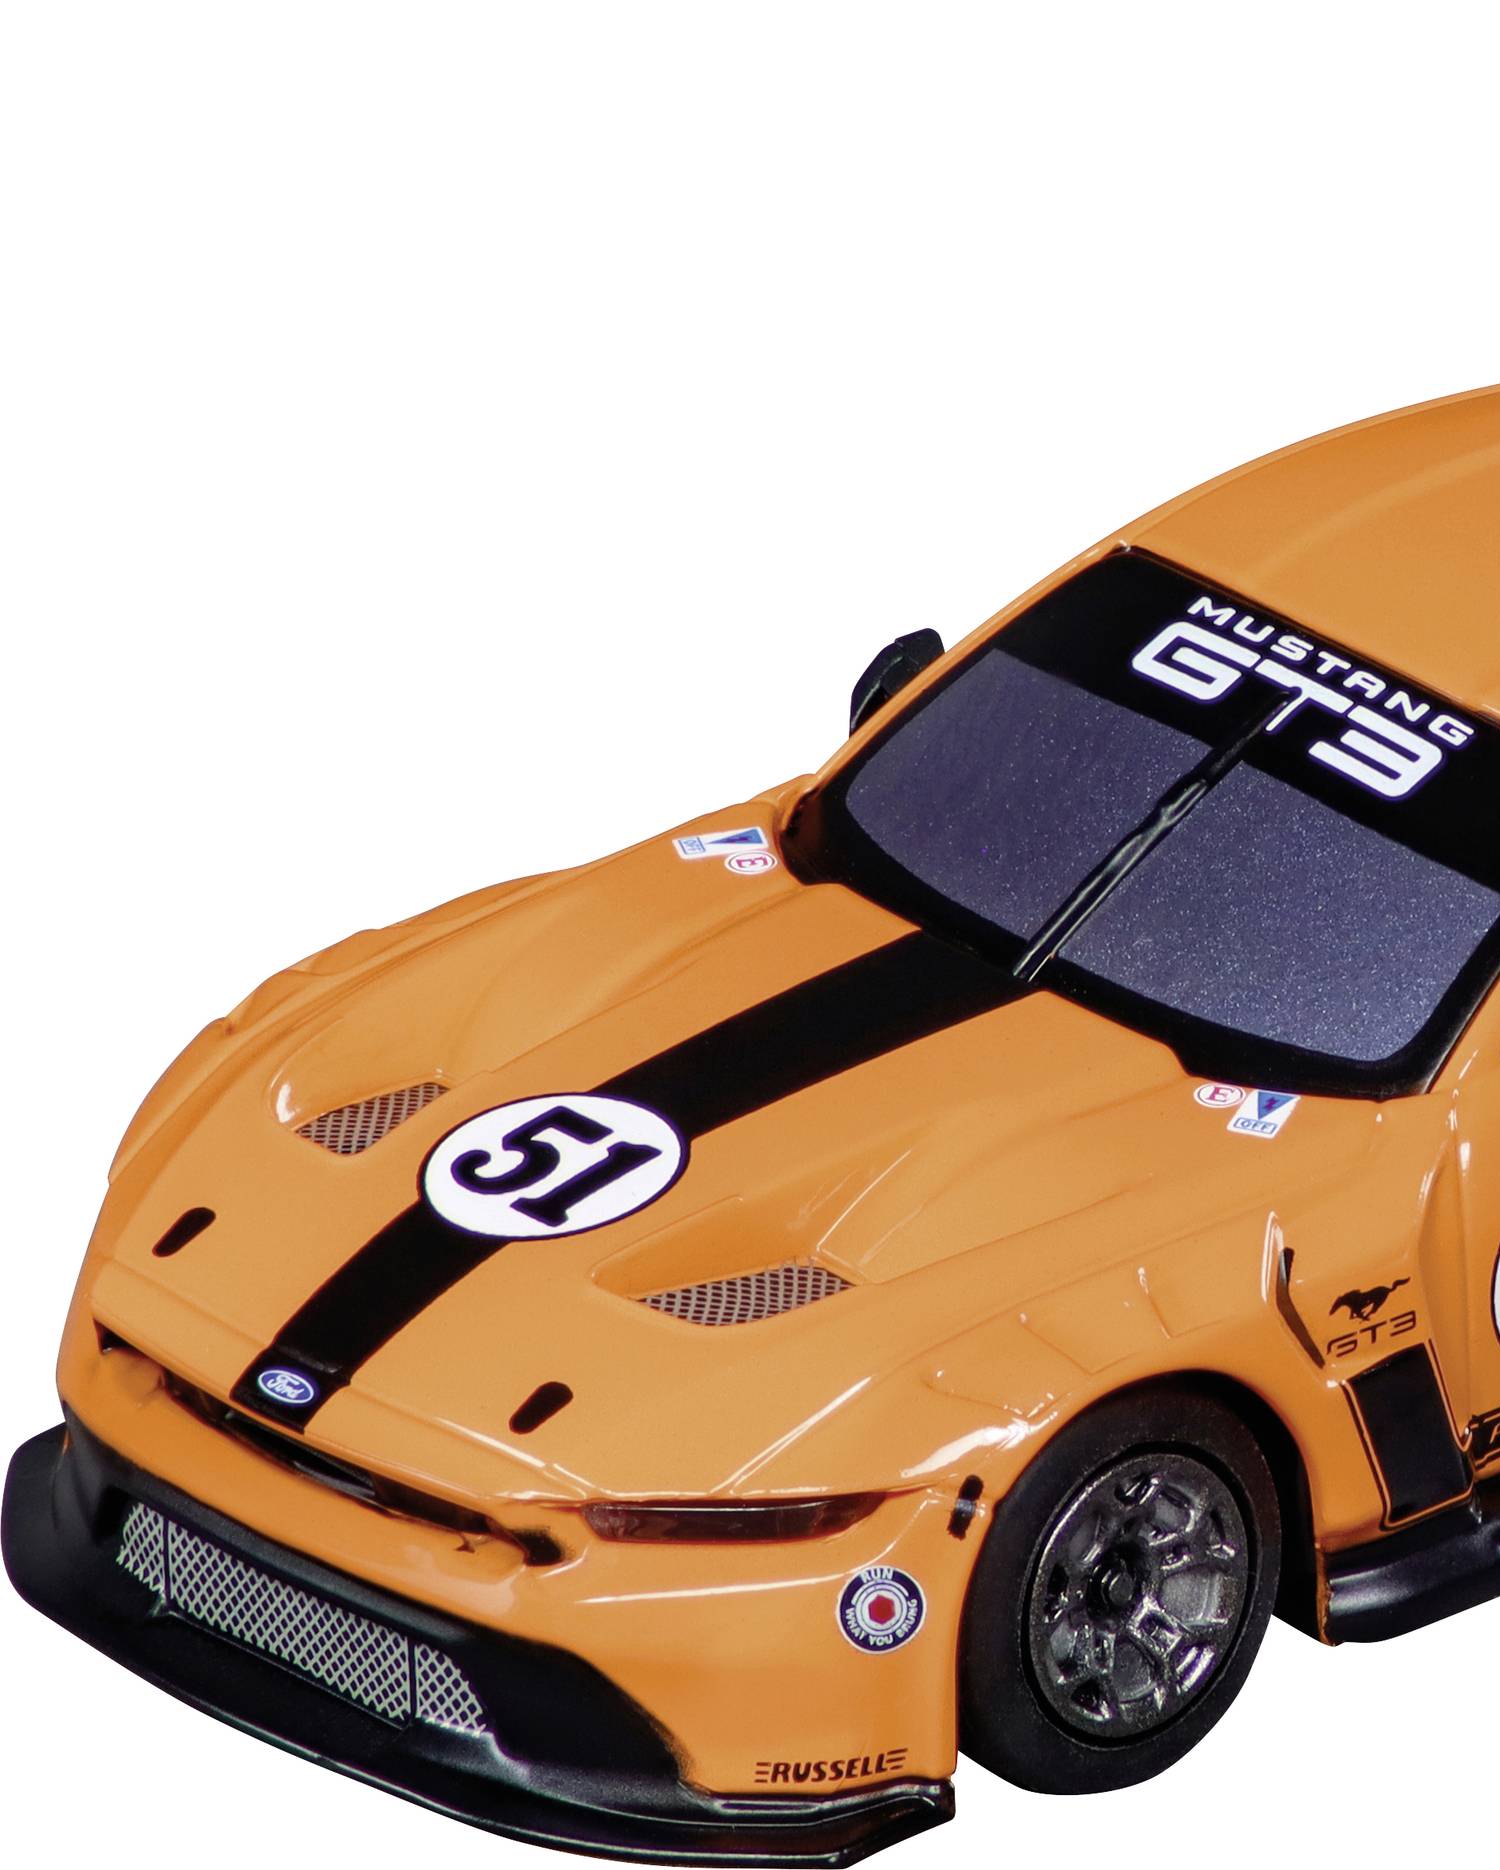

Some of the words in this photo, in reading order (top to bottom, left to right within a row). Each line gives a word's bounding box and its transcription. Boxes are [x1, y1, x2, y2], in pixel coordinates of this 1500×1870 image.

[1187, 596, 1475, 747] MUSTANG
[1132, 621, 1443, 798] GT3
[1205, 1086, 1235, 1103] E
[450, 1105, 663, 1228] 51
[1326, 1310, 1417, 1358] GT3
[266, 1374, 305, 1399] Ford
[860, 1567, 894, 1584] RUN
[845, 1607, 866, 1640] WHAT
[868, 1634, 894, 1647] YOU
[770, 1753, 887, 1783] RUSSELL
